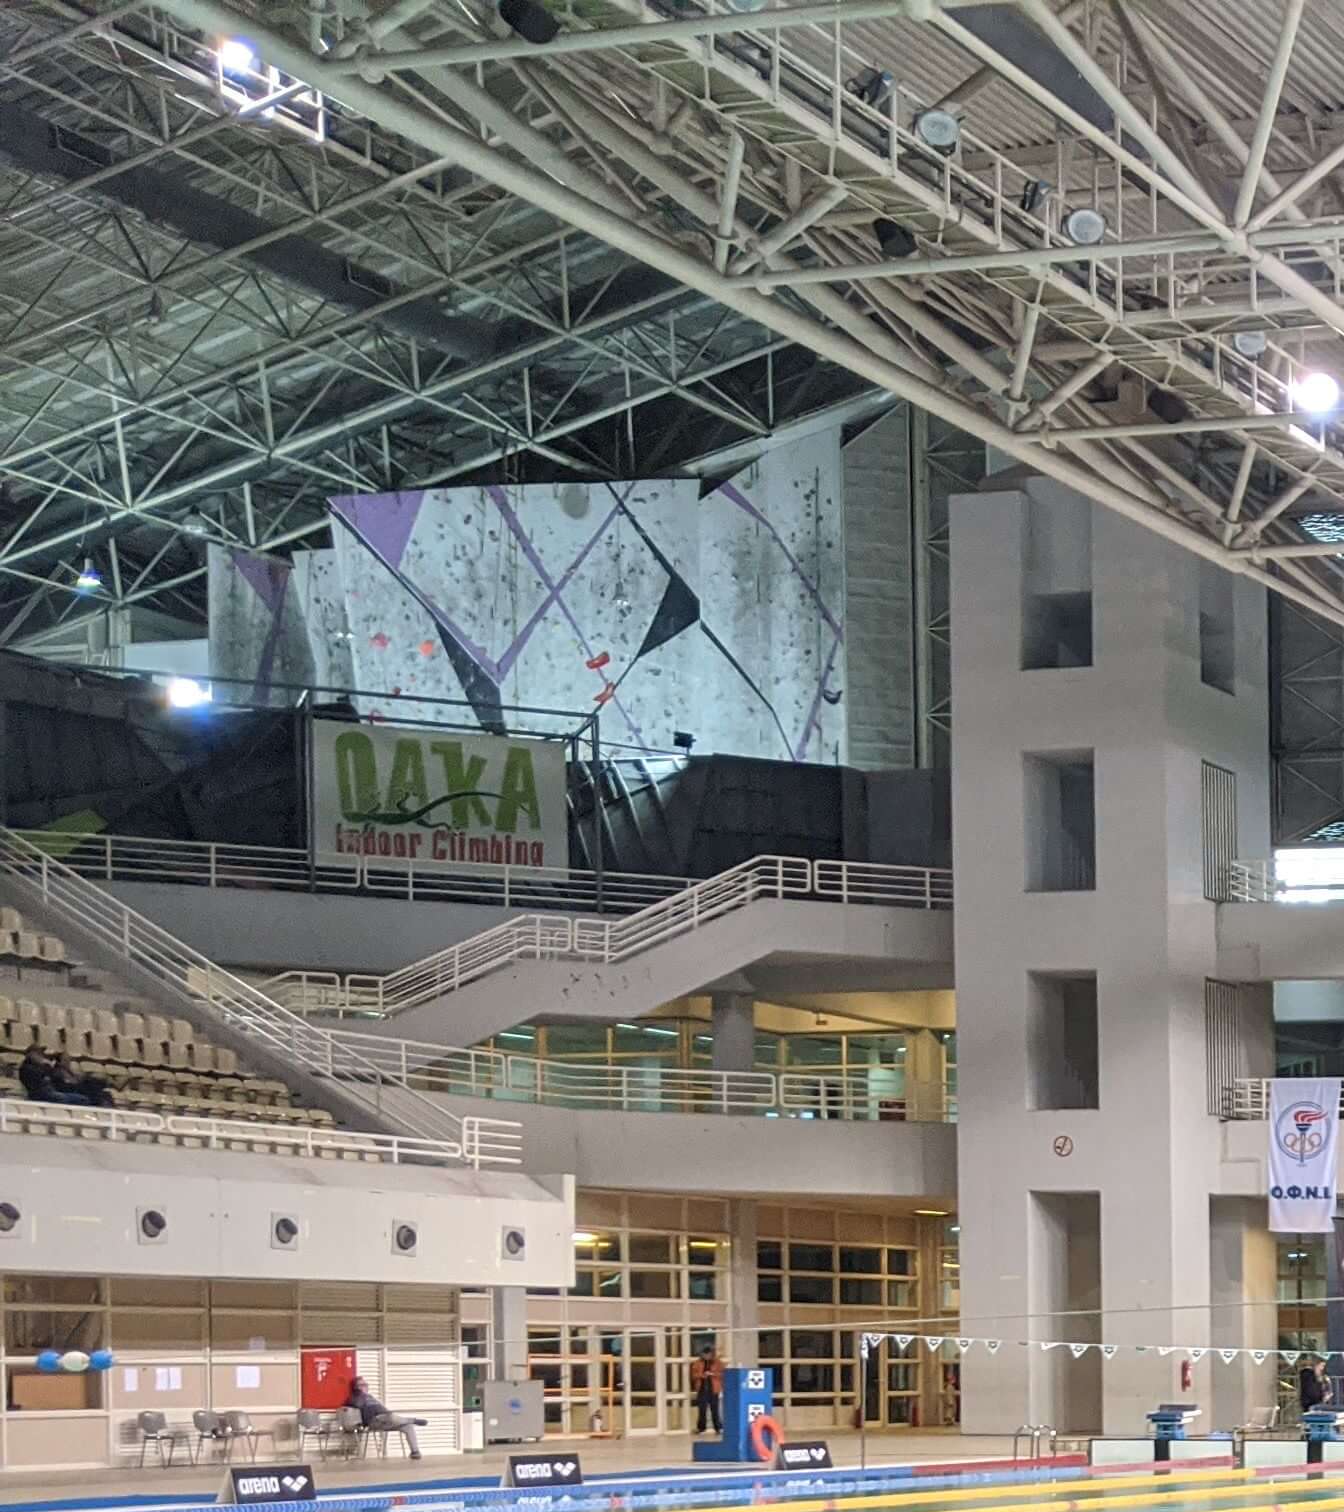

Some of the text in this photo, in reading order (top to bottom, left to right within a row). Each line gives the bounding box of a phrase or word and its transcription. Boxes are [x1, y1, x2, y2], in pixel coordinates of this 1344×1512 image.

[335, 824, 545, 868] Indoor Climbing
[784, 1448, 811, 1462] arena
[515, 1462, 552, 1477] arena
[239, 1477, 280, 1495] arena
